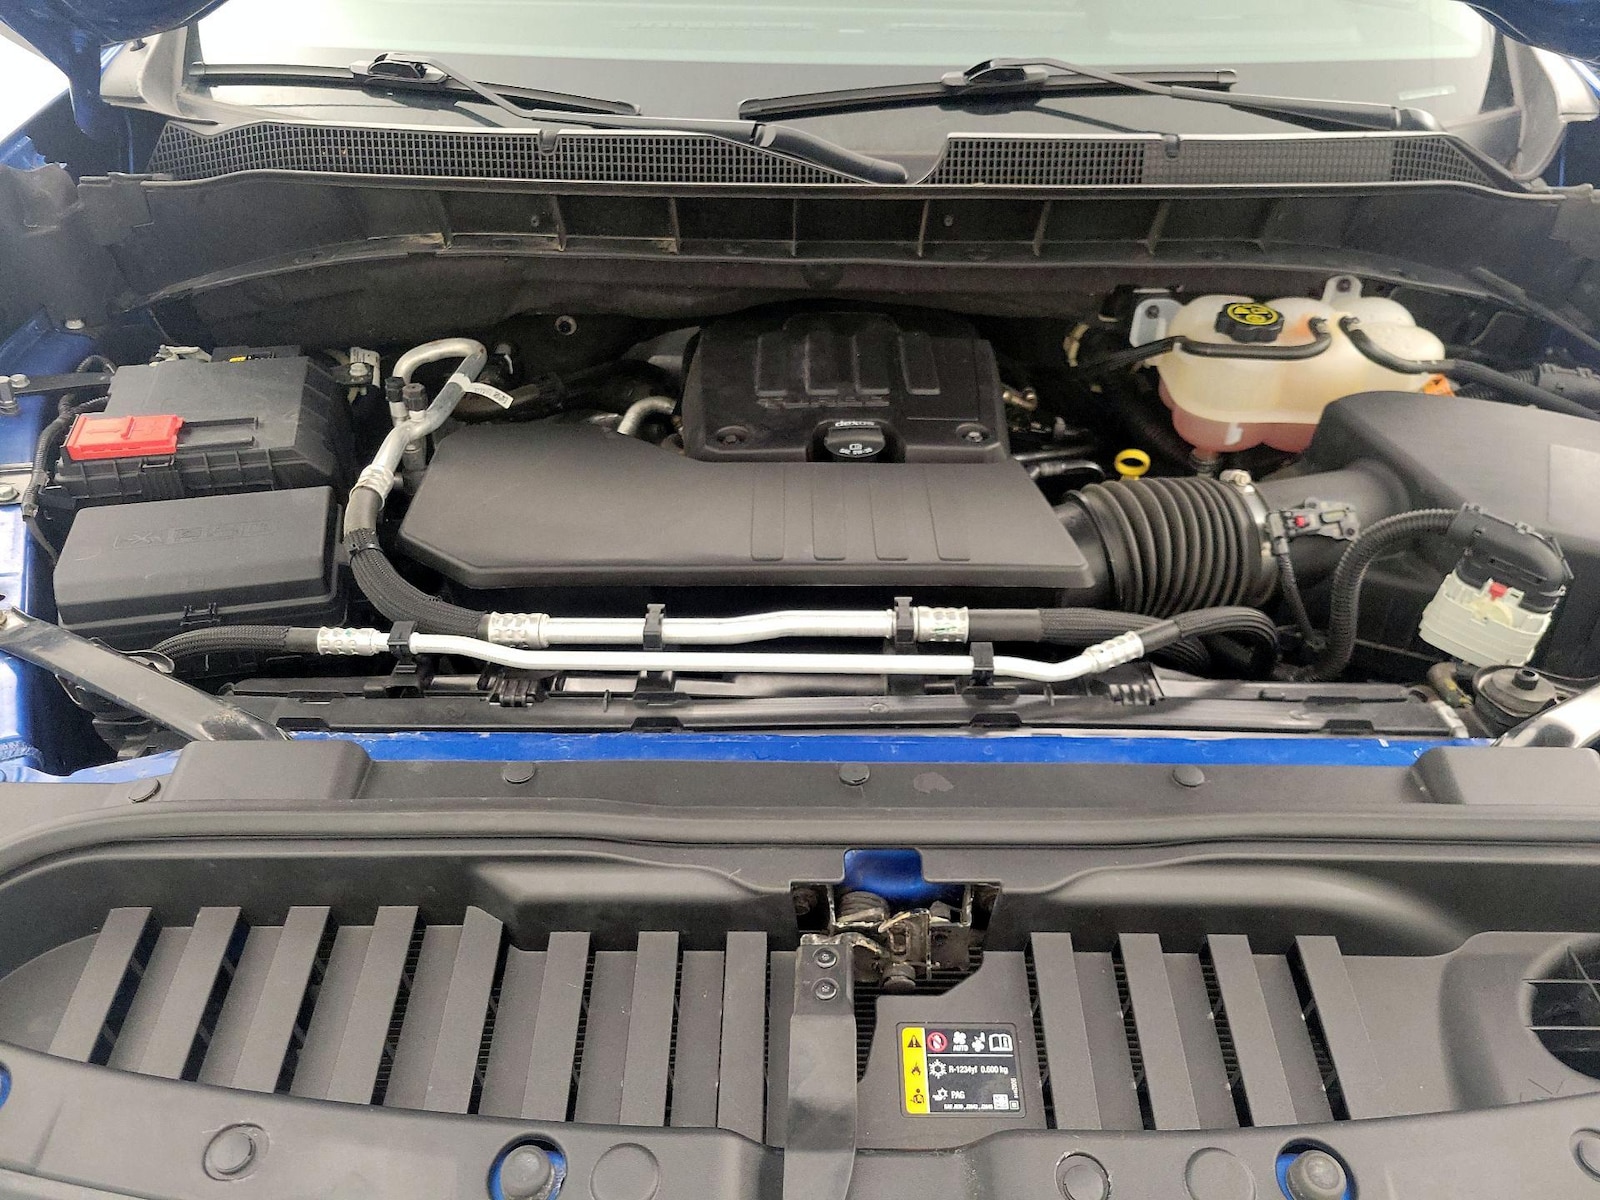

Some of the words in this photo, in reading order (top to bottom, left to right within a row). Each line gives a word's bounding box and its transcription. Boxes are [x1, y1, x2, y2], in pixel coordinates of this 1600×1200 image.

[953, 1044, 969, 1052] AUTO
[948, 1065, 978, 1075] R-1234yf
[999, 1065, 1009, 1075] kg
[950, 1090, 966, 1100] PAG
